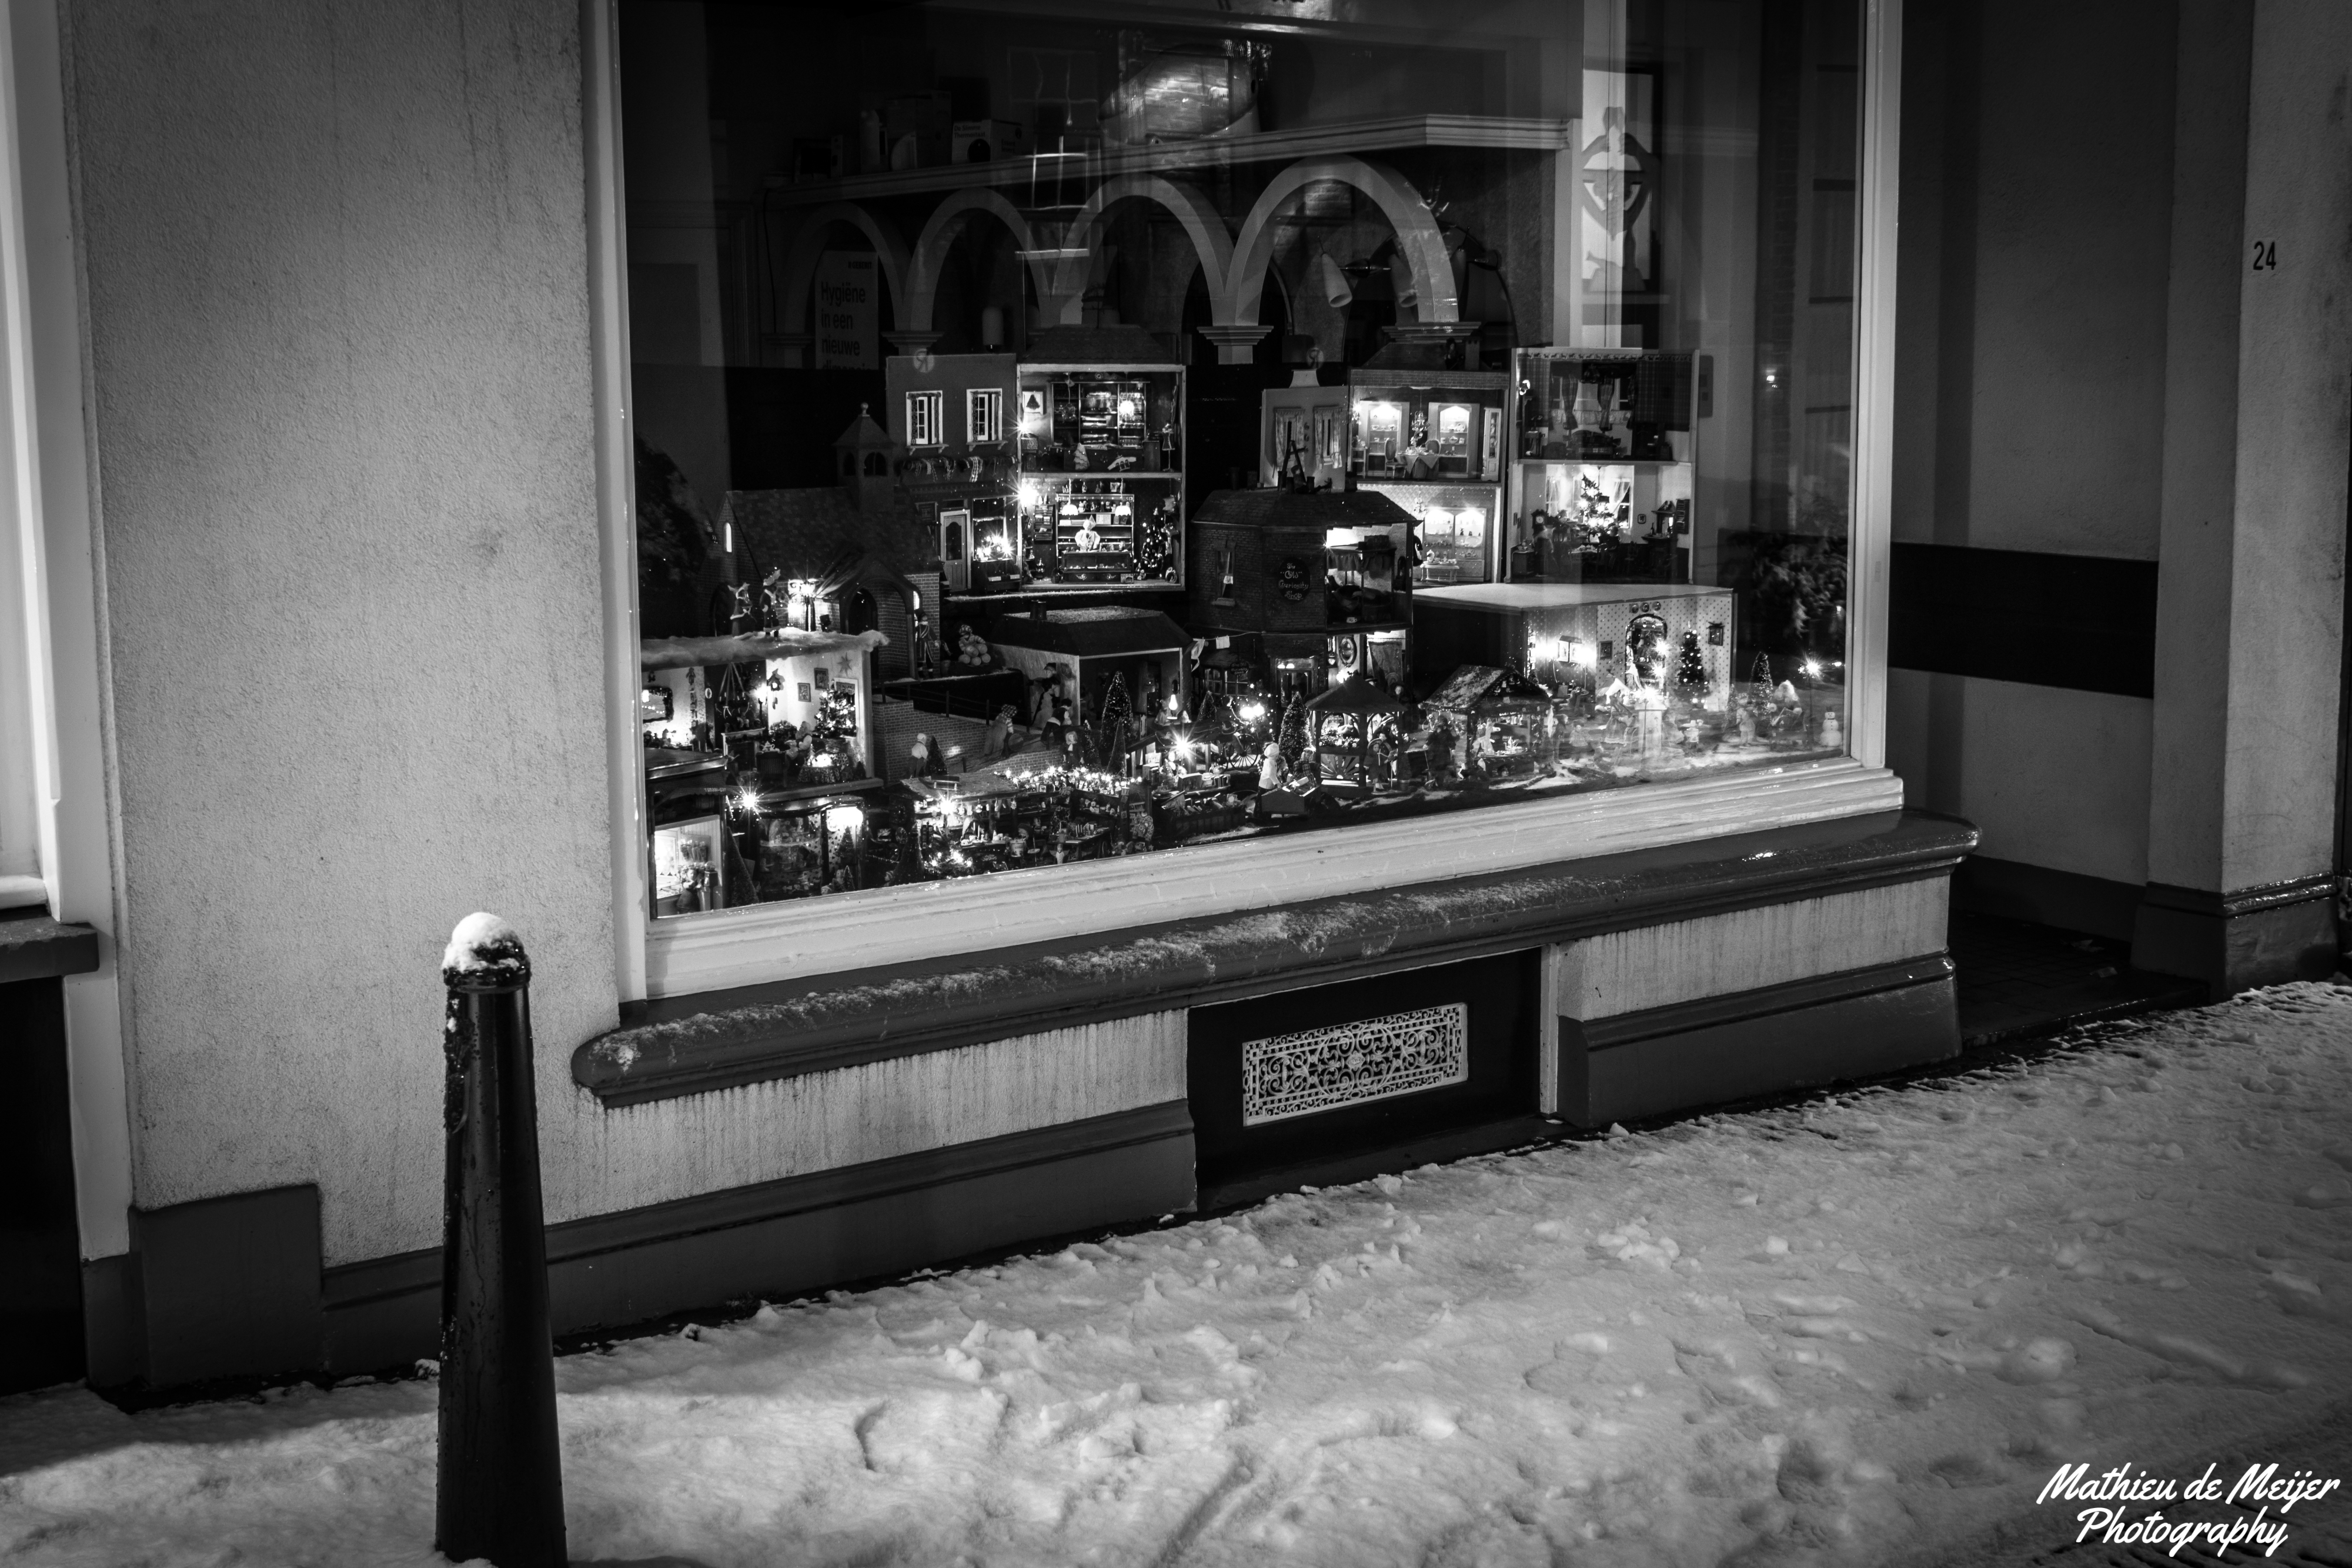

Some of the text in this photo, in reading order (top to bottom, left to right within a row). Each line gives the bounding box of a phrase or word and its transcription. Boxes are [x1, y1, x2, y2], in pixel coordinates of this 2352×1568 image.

[852, 261, 872, 270] GEBERIT
[2253, 241, 2276, 270] 24
[821, 281, 866, 307] Hygiëne
[821, 308, 853, 329] in een
[821, 334, 860, 356] nieuwe
[1284, 590, 1302, 600] Shop
